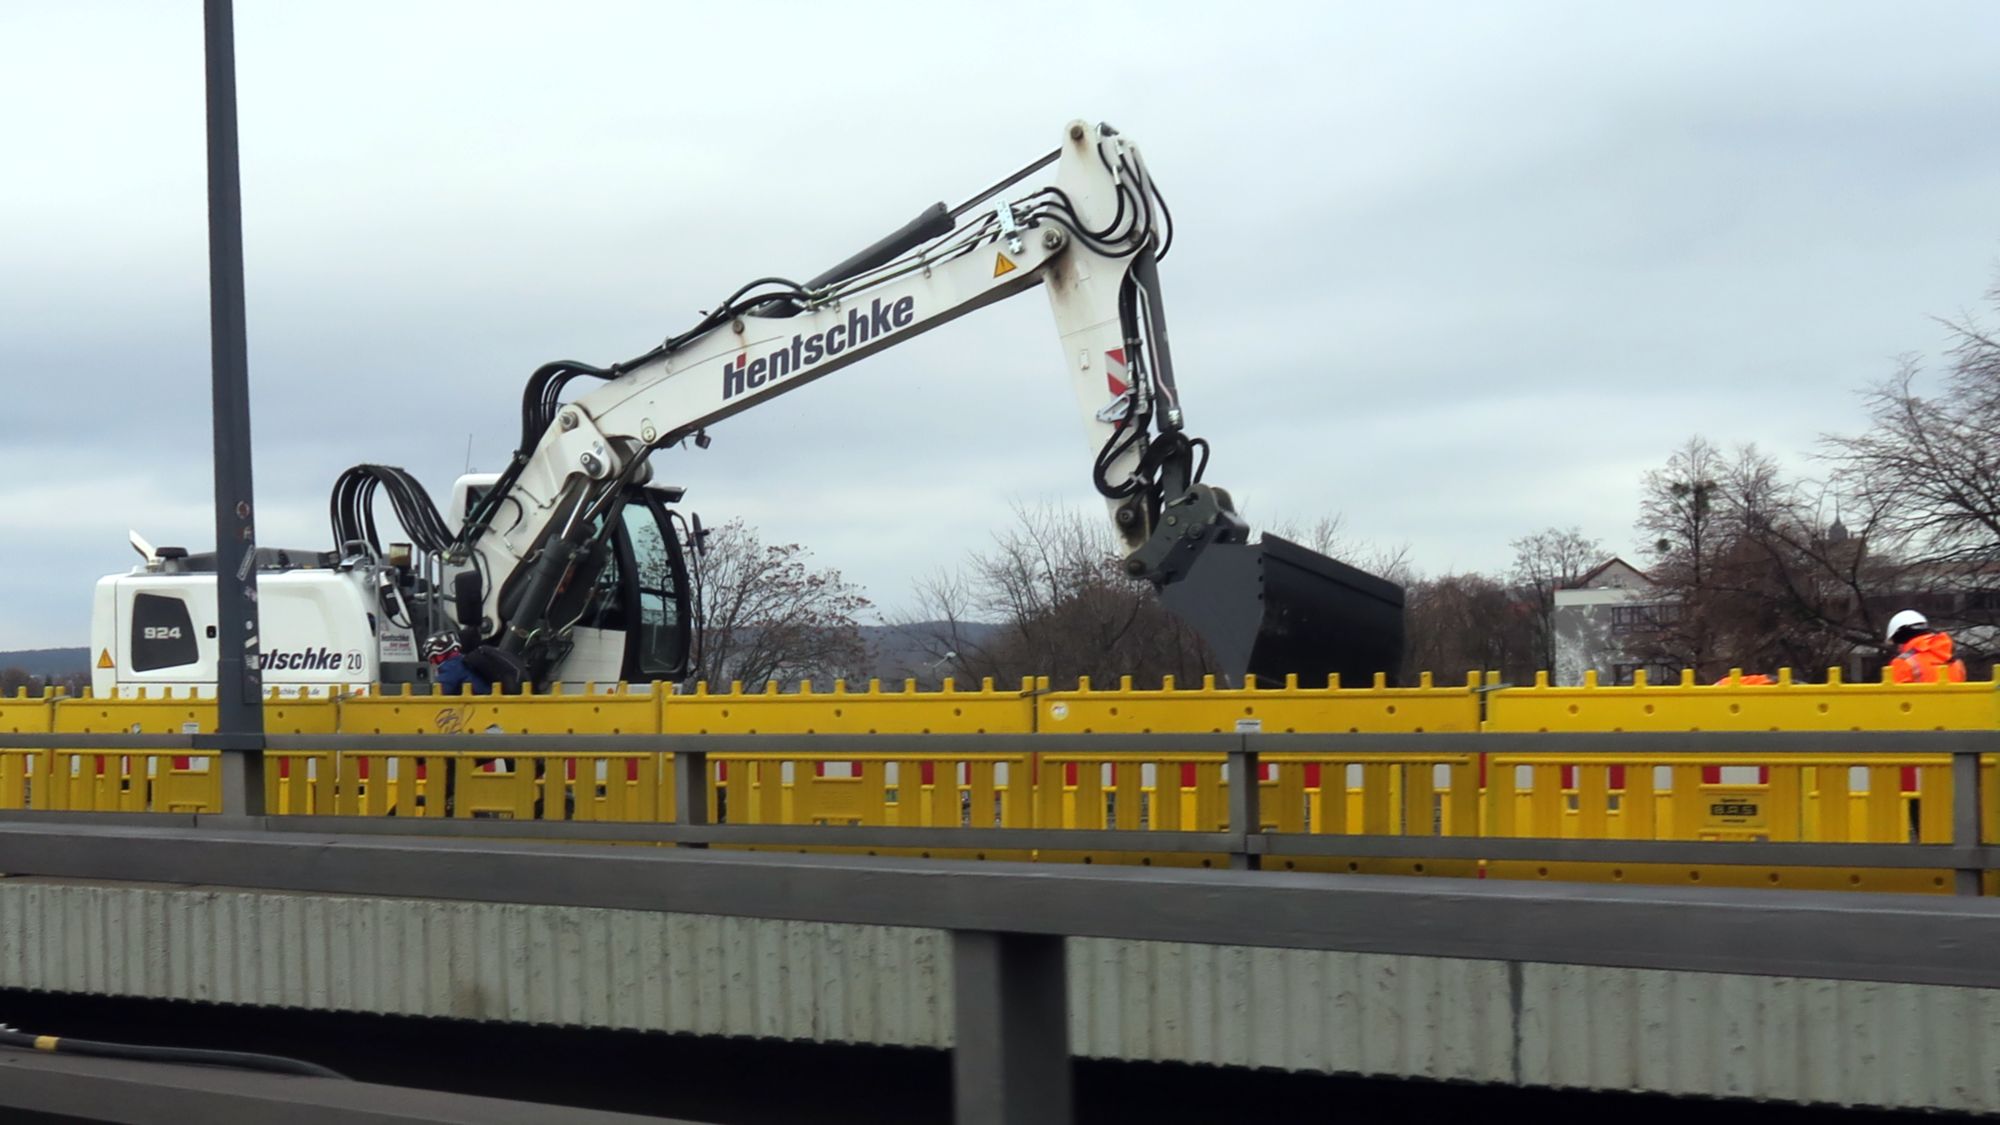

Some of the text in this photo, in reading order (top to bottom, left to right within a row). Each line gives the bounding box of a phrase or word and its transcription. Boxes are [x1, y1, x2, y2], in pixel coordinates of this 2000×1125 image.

[144, 627, 182, 639] 924
[259, 647, 362, 670] ntschke 20
